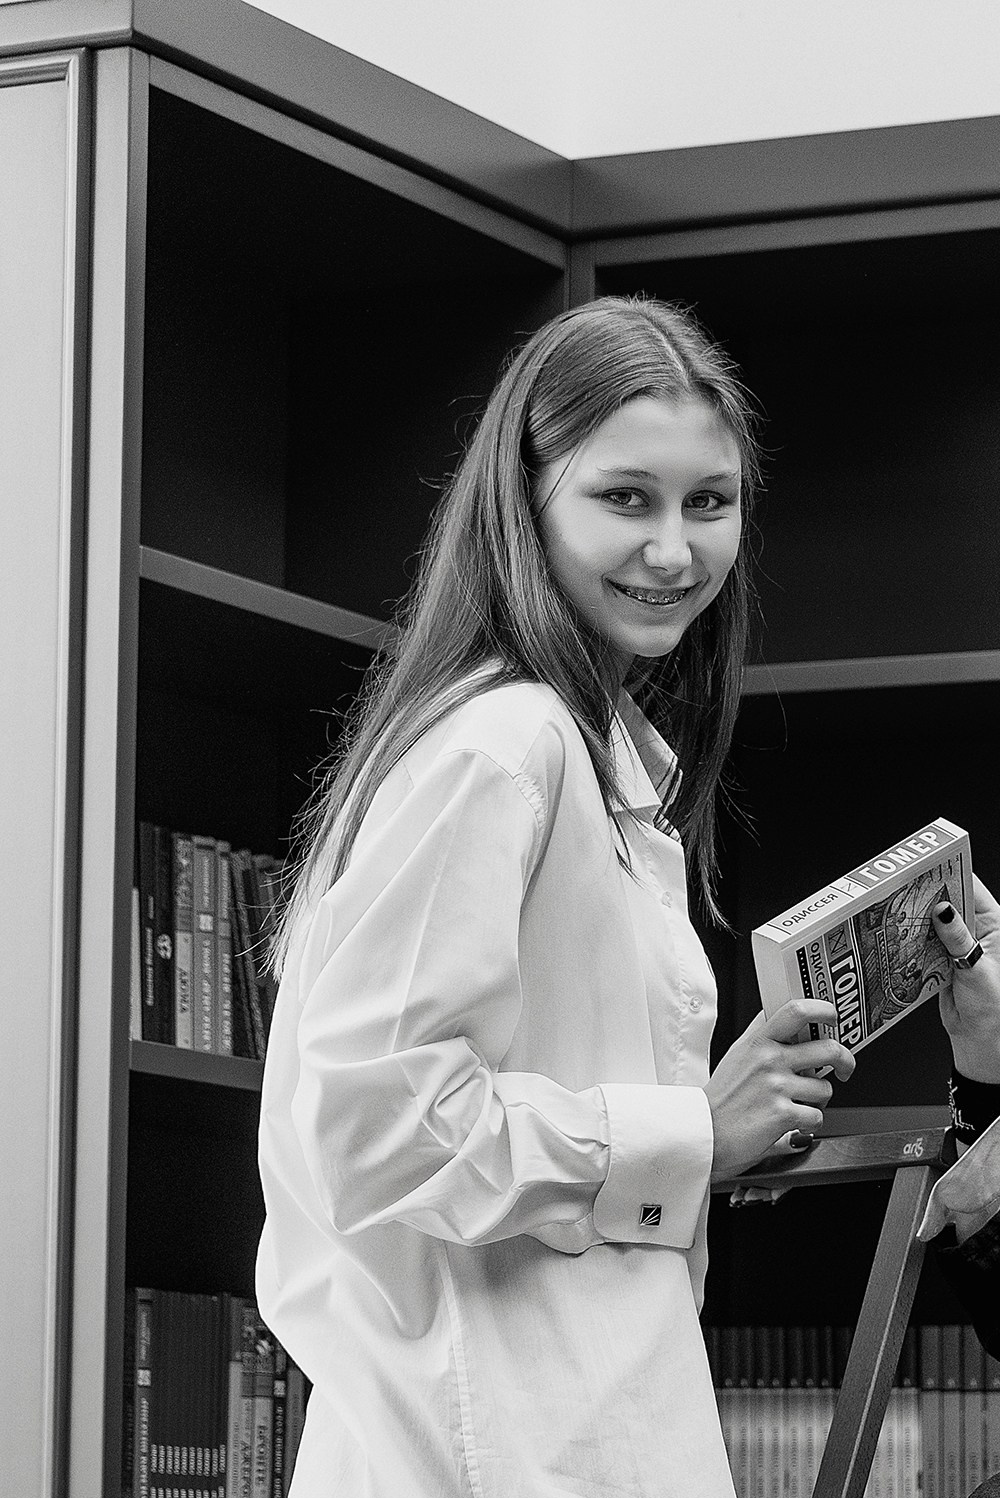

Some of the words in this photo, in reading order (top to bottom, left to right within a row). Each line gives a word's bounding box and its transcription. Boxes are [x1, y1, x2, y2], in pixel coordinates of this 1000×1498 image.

[858, 831, 941, 883] ГОМЕР
[781, 892, 840, 928] ОДИССЕЯ
[830, 954, 862, 1046] ГОМЕР
